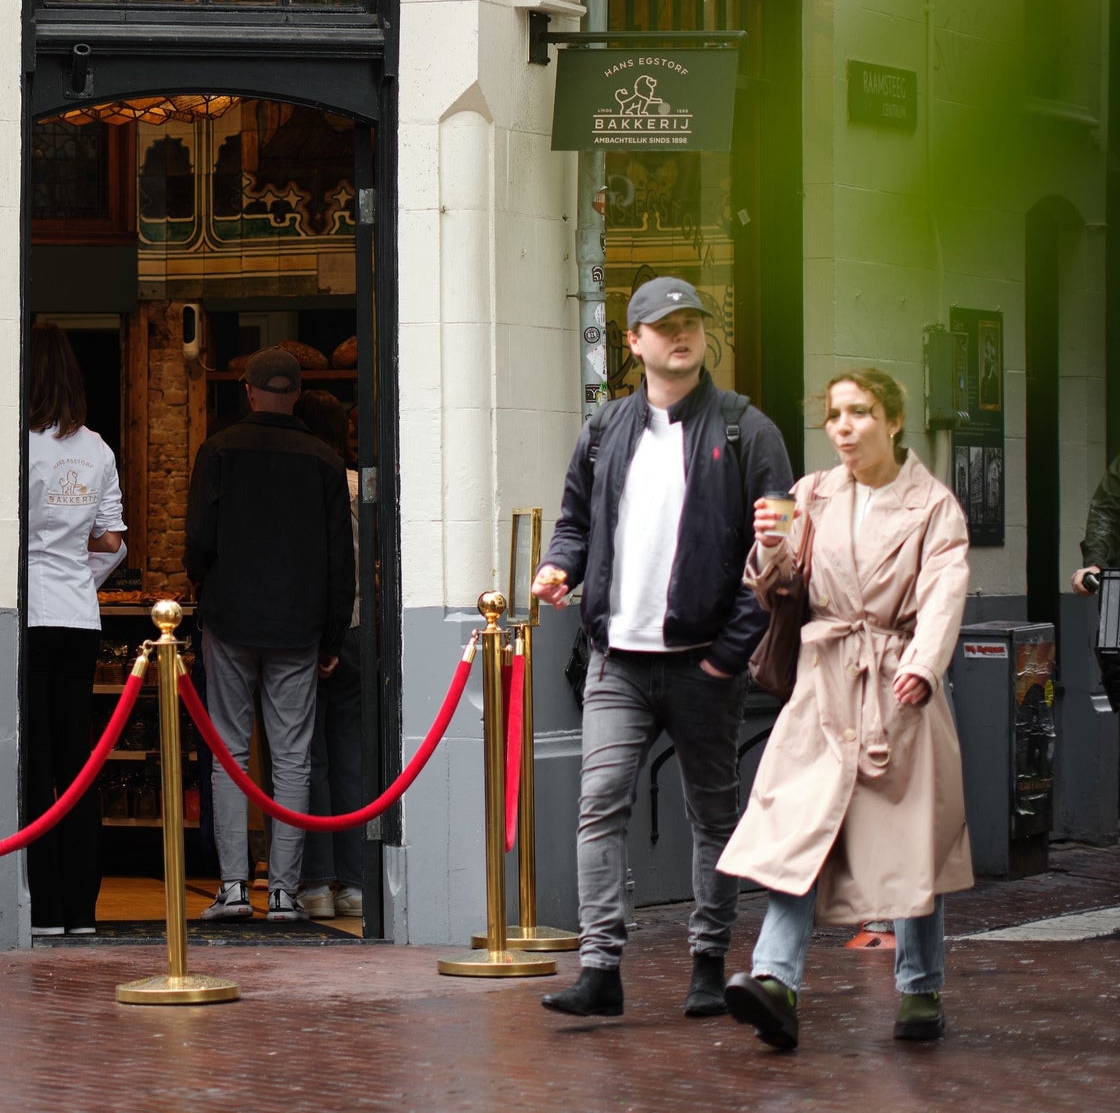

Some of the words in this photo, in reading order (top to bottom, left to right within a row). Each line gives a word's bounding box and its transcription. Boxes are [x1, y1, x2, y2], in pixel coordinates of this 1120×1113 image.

[604, 59, 634, 78] HANS
[638, 57, 689, 77] EGSTORF
[594, 118, 690, 130] BAKKERIJ
